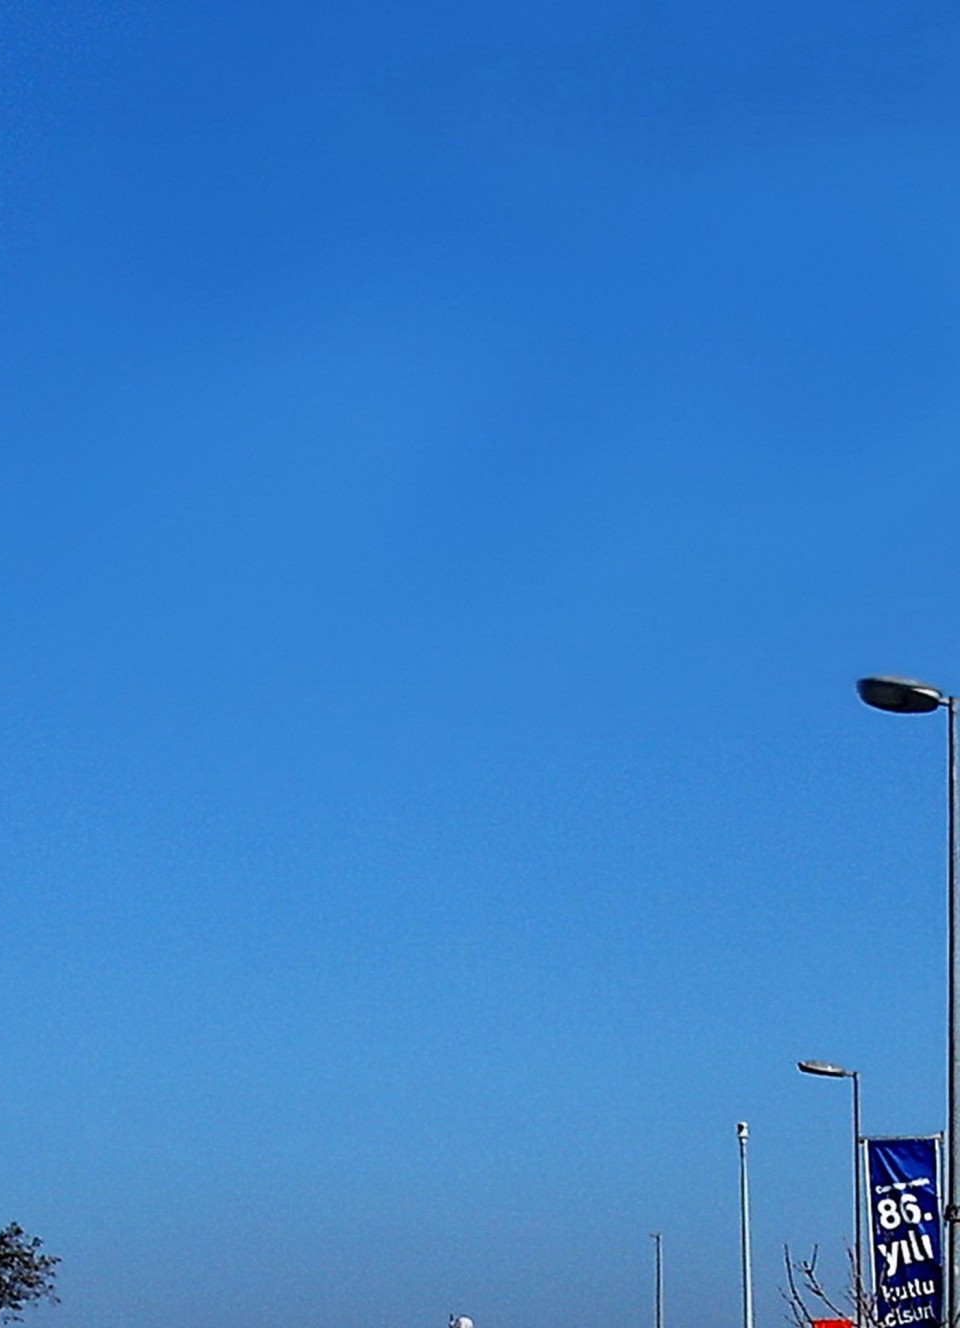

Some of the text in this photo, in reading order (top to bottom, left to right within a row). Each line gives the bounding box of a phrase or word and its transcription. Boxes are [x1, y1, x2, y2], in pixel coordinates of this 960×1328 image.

[877, 1193, 933, 1230] 86.
[877, 1230, 934, 1277] yılı
[881, 1278, 935, 1302] kutlu
